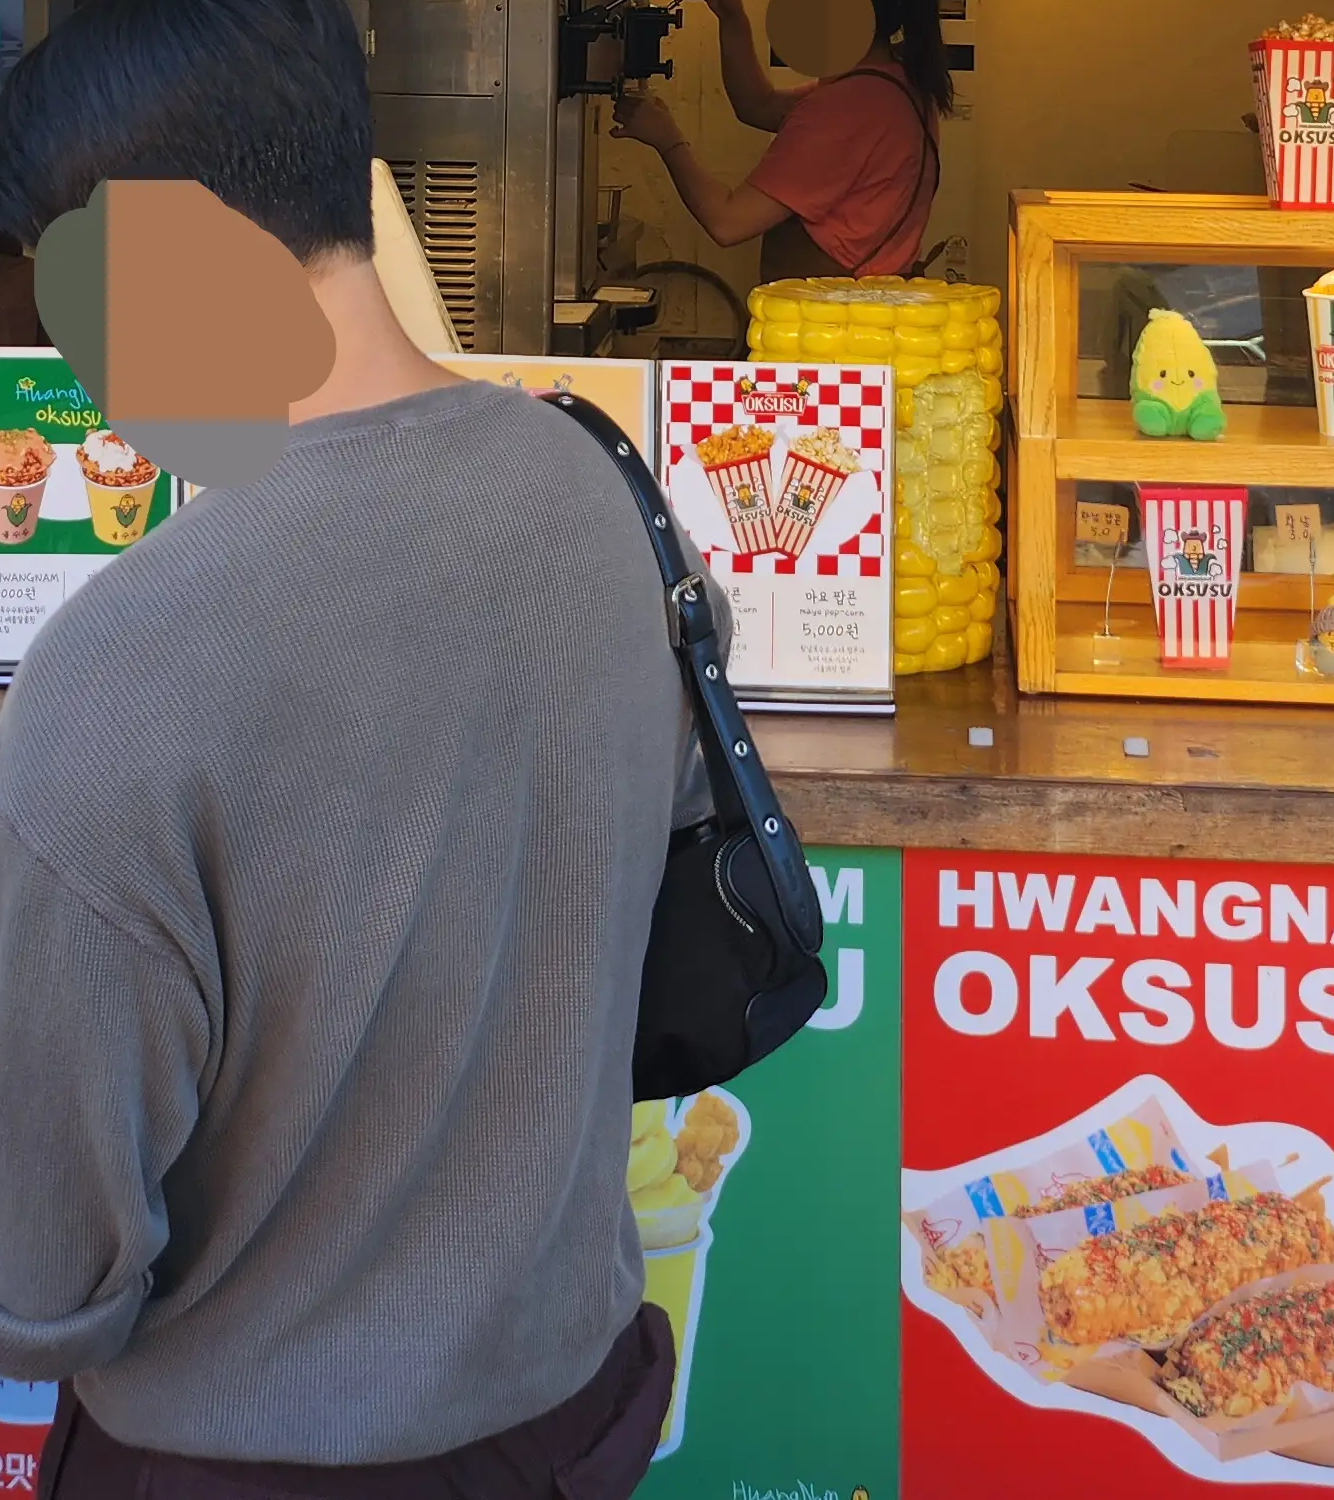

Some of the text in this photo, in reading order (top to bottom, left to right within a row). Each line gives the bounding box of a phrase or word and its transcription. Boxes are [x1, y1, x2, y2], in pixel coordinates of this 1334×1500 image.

[745, 396, 804, 413] OKSUSU
[729, 506, 772, 524] OKSUSU
[777, 504, 818, 527] OKSUSU
[805, 589, 857, 606] 마요 팝콘
[1158, 583, 1233, 597] OKSUSU
[802, 621, 859, 639] 5,000원
